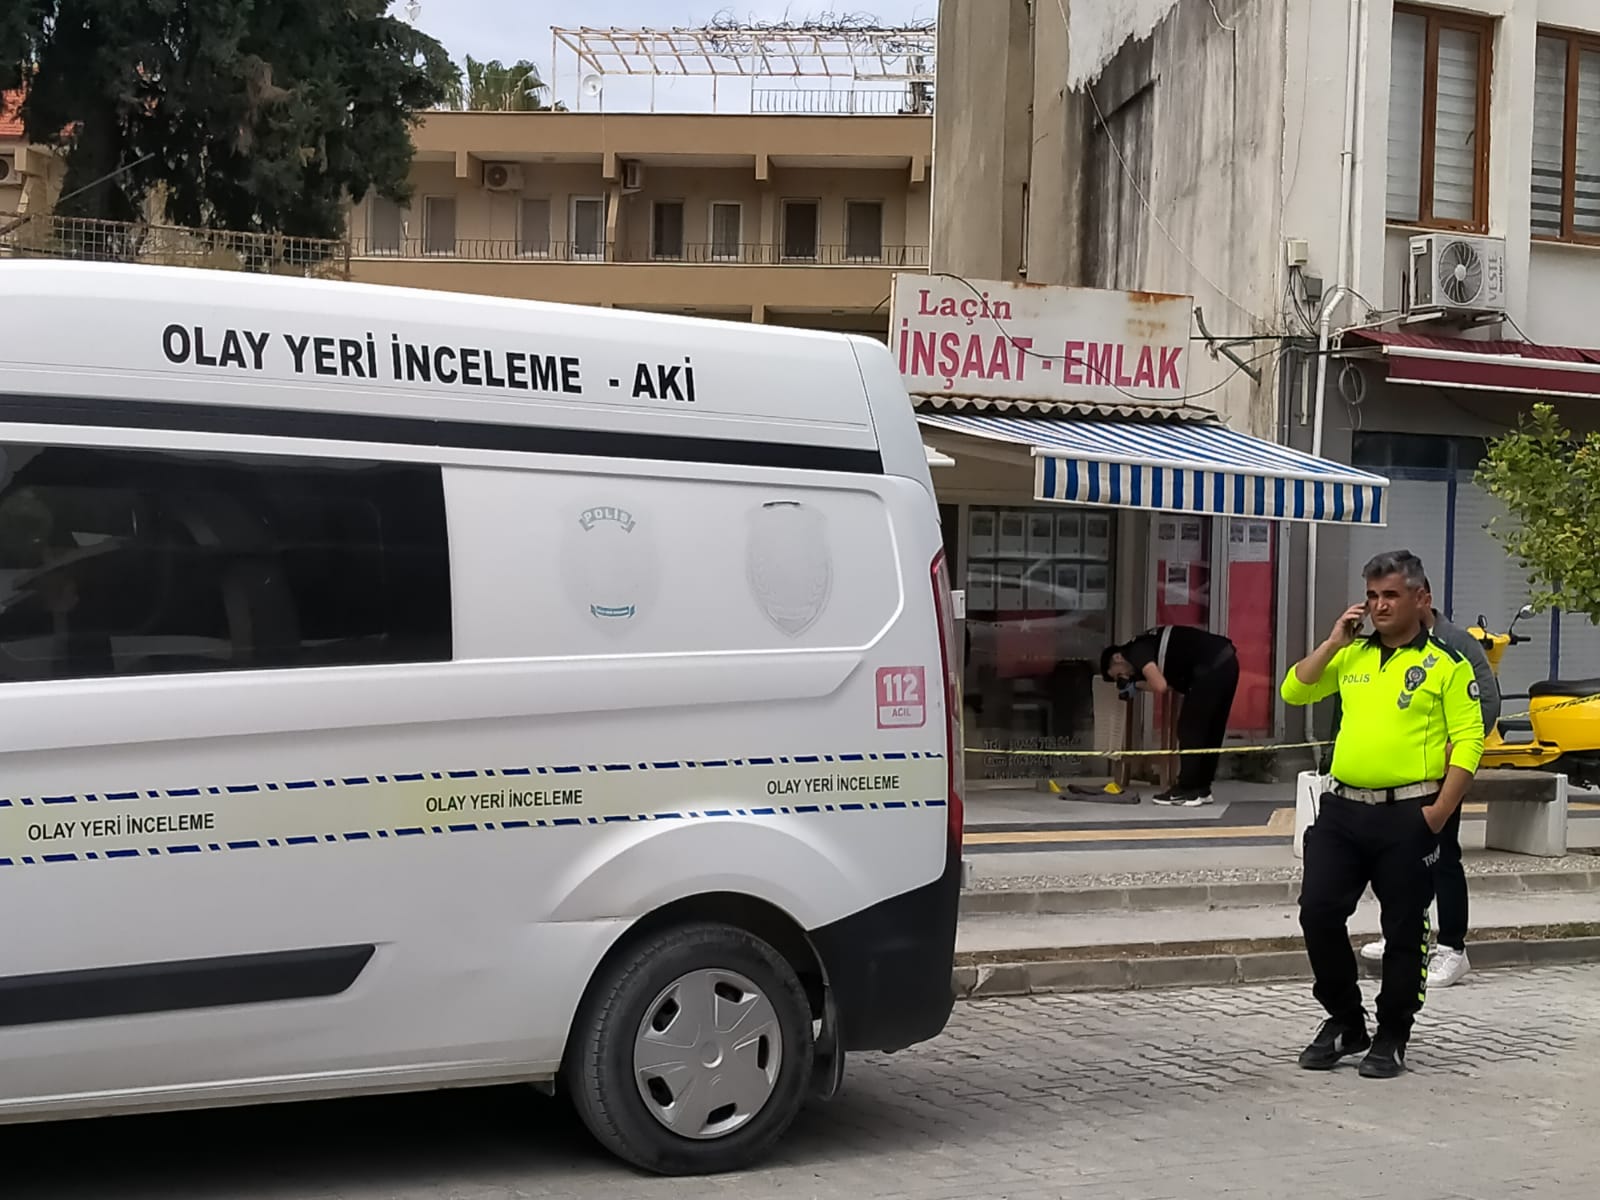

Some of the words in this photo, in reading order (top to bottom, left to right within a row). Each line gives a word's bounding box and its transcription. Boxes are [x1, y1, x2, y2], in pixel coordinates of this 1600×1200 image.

[918, 289, 1012, 325] Laçin
[162, 324, 270, 370] OLAY
[283, 332, 377, 379] YERİ
[391, 333, 583, 394] İNCELEME
[609, 379, 620, 388] -
[632, 356, 696, 402] AKİ
[899, 317, 1033, 390] İNŞAAT
[1041, 359, 1052, 370] -
[1063, 340, 1184, 390] EMLAK
[883, 673, 919, 702] 112
[767, 779, 801, 795] OLAY
[804, 774, 834, 793] YERİ
[837, 774, 900, 791] İNCELEME
[426, 795, 466, 812] OLAY
[470, 789, 504, 810] YERİ
[509, 789, 583, 808] İNCELEME
[28, 822, 76, 841] OLAY
[80, 815, 121, 837] YERİ
[126, 813, 215, 835] İNCELEME
